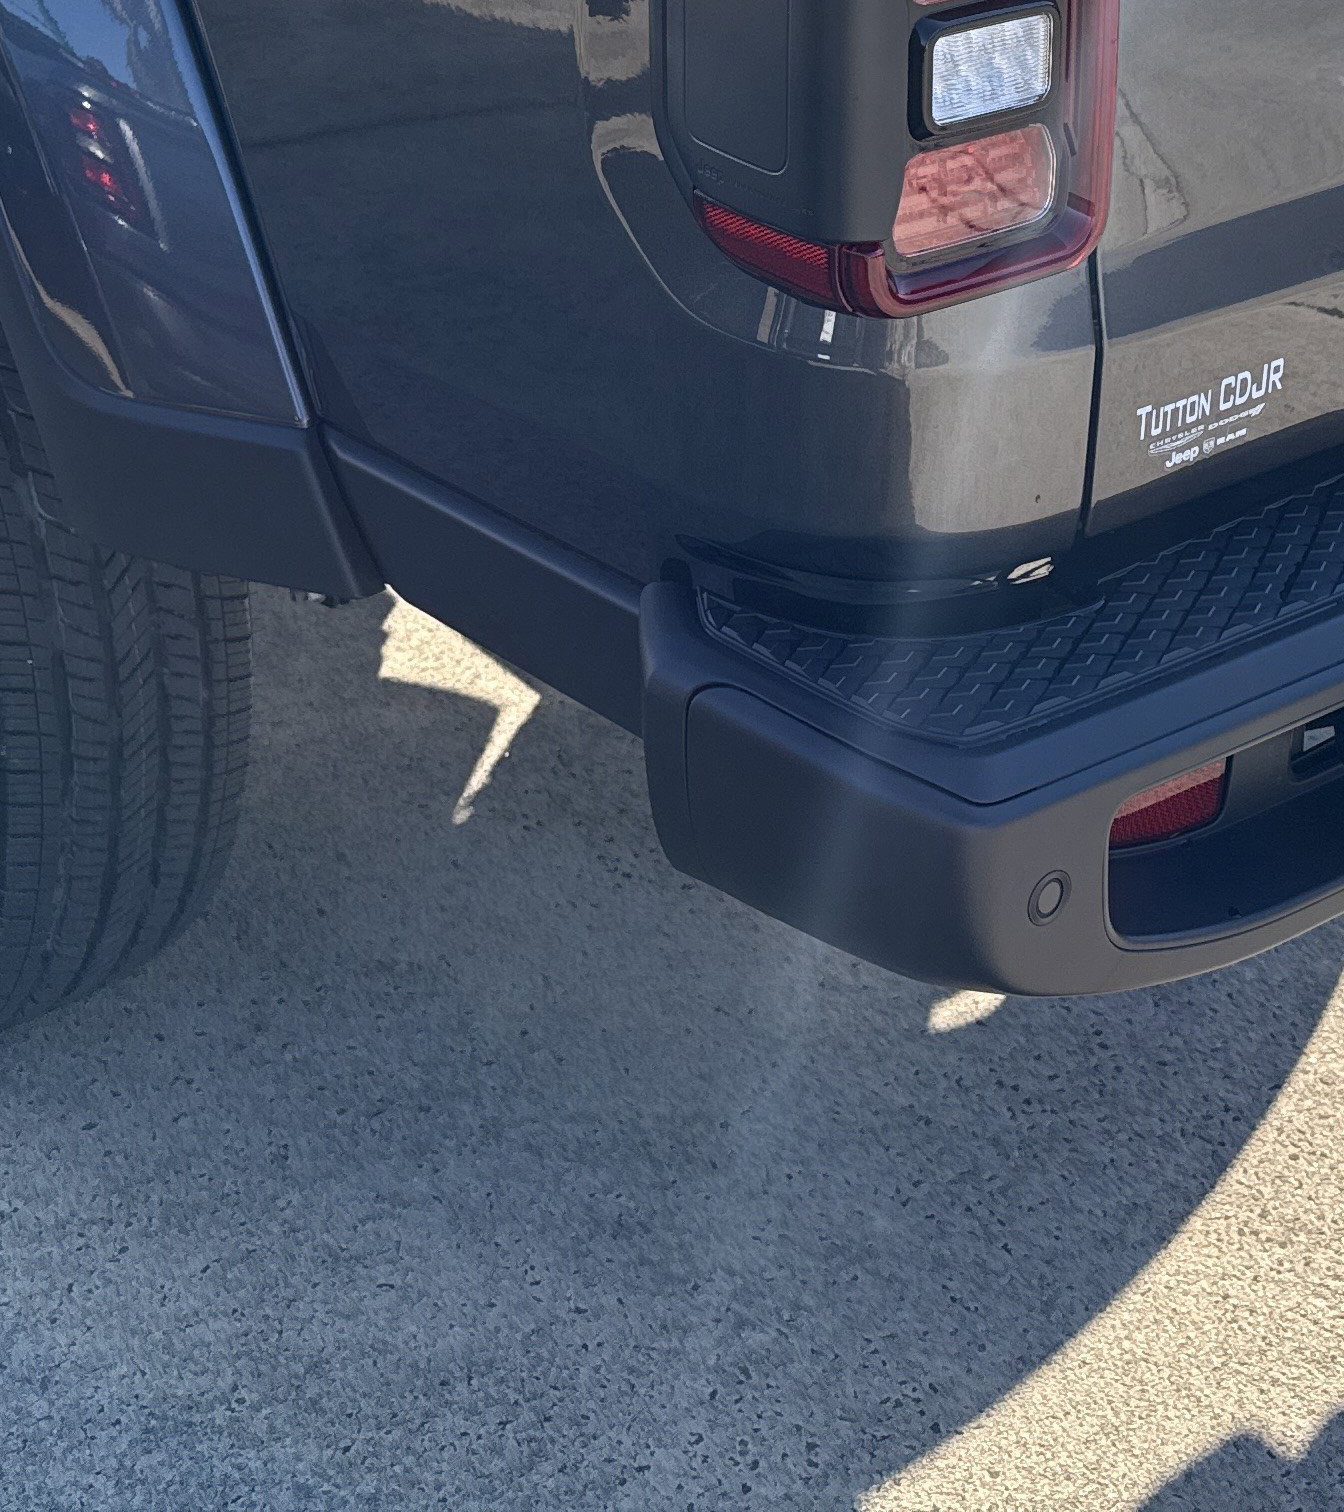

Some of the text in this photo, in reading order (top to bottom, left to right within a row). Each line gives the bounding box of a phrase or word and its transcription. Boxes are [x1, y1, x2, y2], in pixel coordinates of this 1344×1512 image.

[1136, 357, 1285, 441] TUTTON CDJR
[1149, 424, 1205, 450] CHRYSLER
[1165, 428, 1248, 468] Jeep RAM
